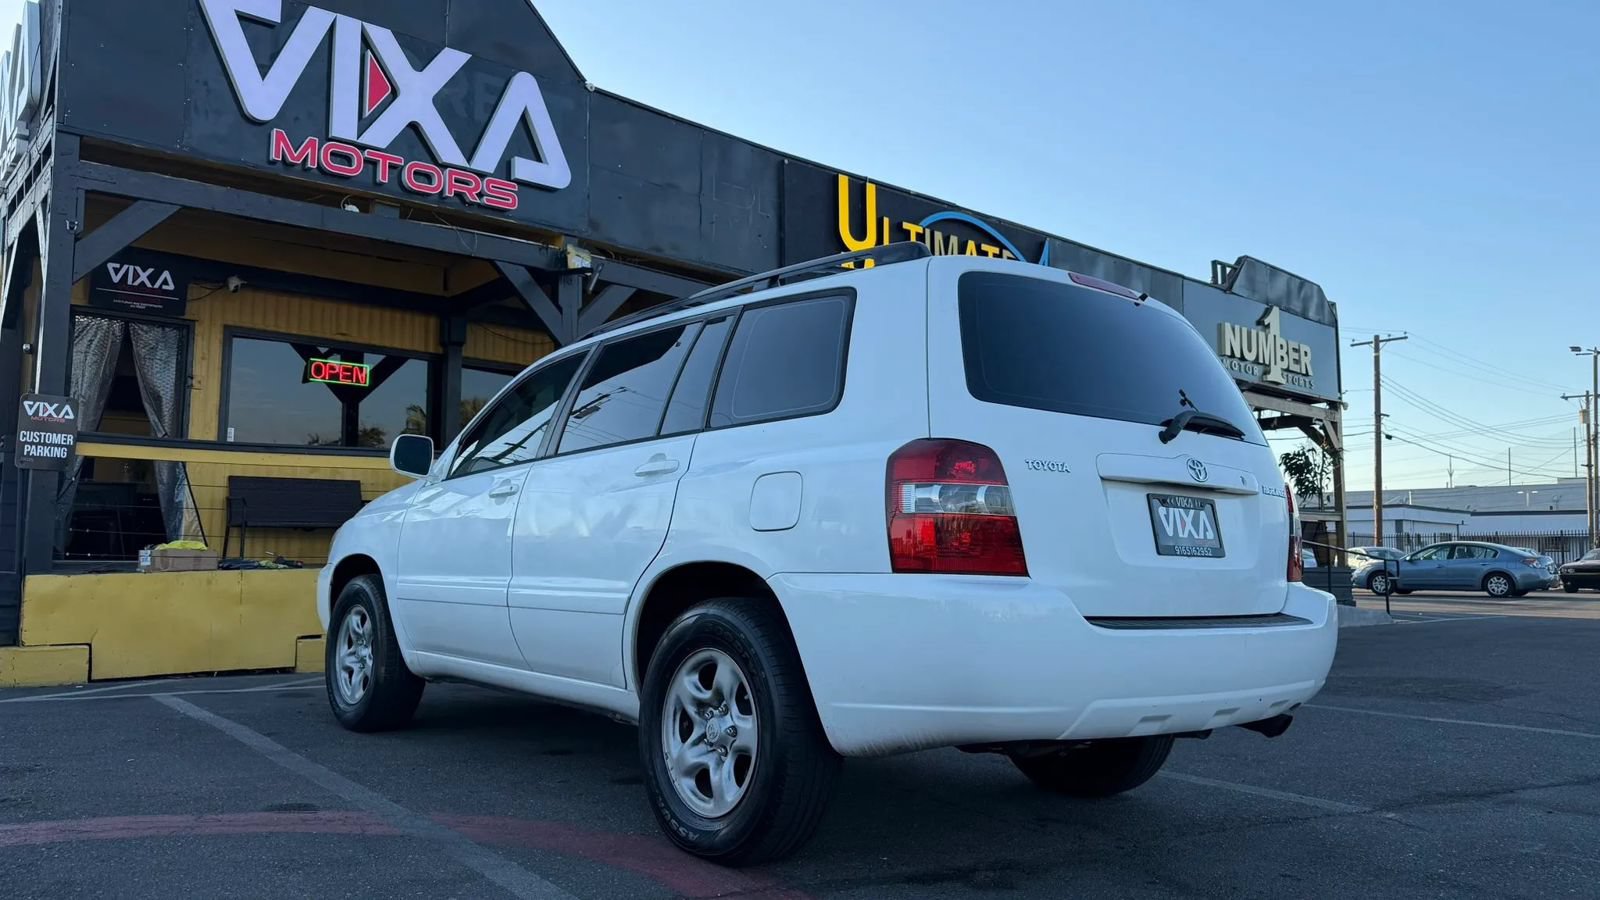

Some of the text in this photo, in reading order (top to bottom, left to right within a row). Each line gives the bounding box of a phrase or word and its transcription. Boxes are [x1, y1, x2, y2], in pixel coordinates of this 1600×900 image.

[200, 0, 571, 190] VIXA
[269, 128, 519, 211] MOTORS
[106, 262, 175, 291] VIXA
[1221, 321, 1314, 377] NUMBER
[310, 361, 367, 384] OPEN
[23, 400, 75, 420] VIXA
[19, 430, 74, 446] CUSTOMER
[23, 445, 68, 459] PARKING
[1025, 459, 1071, 473] TOYOTA
[1175, 496, 1194, 508] VIXA
[1158, 506, 1215, 540] VIXA
